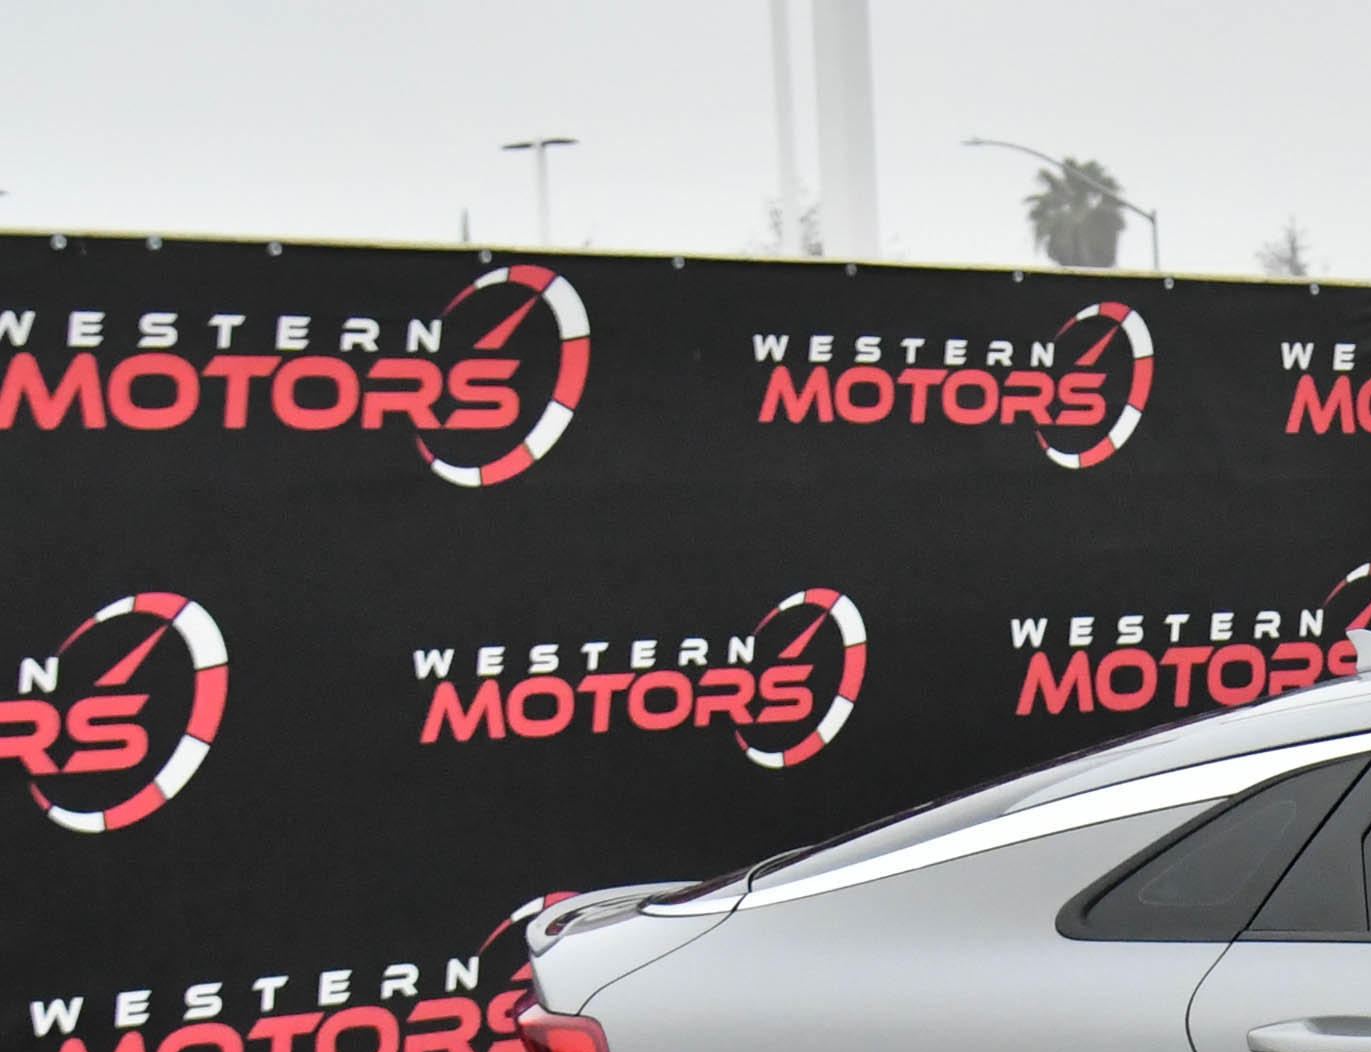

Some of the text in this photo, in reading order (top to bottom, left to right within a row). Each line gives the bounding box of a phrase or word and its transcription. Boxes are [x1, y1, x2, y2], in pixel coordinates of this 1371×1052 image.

[0, 310, 442, 353] WESTERN
[754, 334, 1055, 367] WESTERN
[0, 352, 520, 431] MOTORS
[758, 366, 1107, 425] MOTORS
[1011, 608, 1324, 649] WESTERN
[414, 636, 755, 679] WESTERN
[420, 664, 814, 744] MOTORS
[30, 956, 480, 1037] WESTERN
